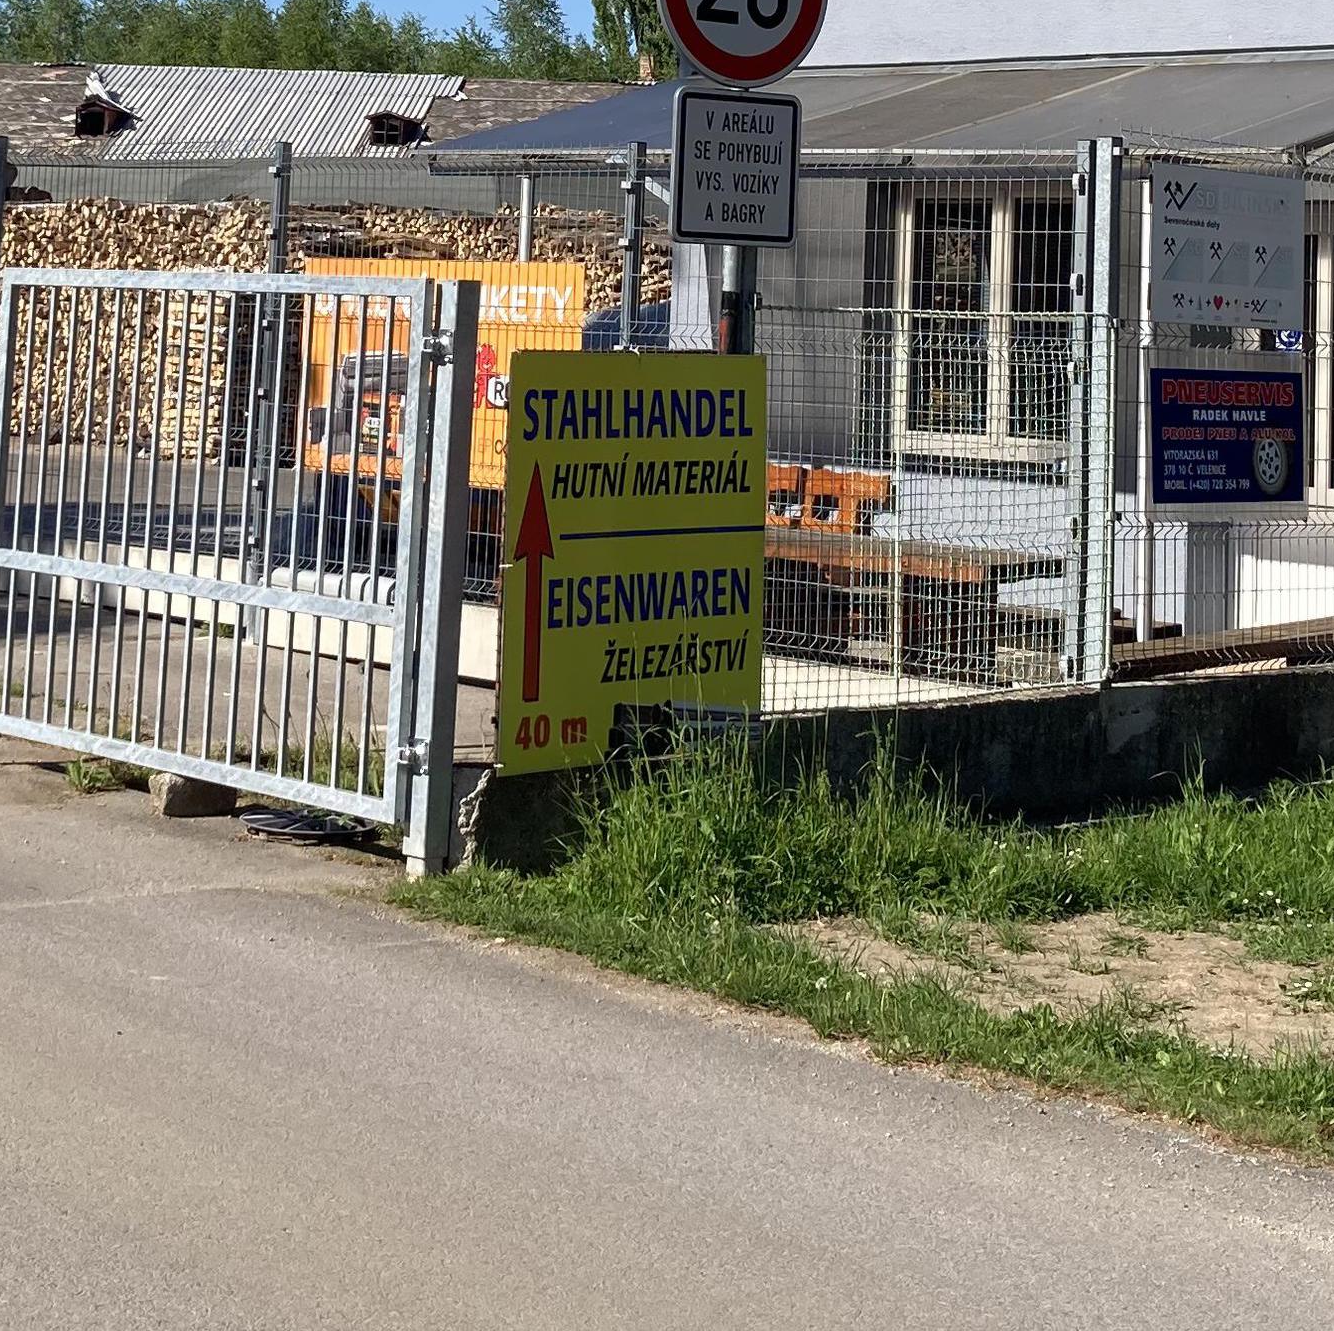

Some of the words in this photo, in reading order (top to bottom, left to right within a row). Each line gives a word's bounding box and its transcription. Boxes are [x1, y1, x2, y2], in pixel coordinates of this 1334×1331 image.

[706, 111, 715, 131] V
[722, 108, 774, 135] AREÁLU
[695, 141, 711, 160] SE
[718, 140, 782, 165] POHYBUJÍ
[696, 170, 725, 192] VYS.
[733, 168, 779, 195] VOZÍKY
[705, 202, 714, 222] A
[721, 204, 766, 224] BAGRY
[1196, 189, 1216, 210] SD
[479, 284, 573, 325] IKETY
[1162, 379, 1294, 407] PNEUSERVIS
[523, 389, 753, 442] STAHLHANDEL
[1192, 409, 1229, 421] RADEK
[1232, 410, 1266, 422] HAVLE
[1162, 427, 1204, 440] PRODEJ
[1207, 427, 1237, 440] PNEU
[1239, 428, 1248, 440] A
[1163, 449, 1205, 460] VITORAZSKÁ
[551, 453, 629, 499] HUTNÍ
[632, 451, 751, 498] MATERIÁL
[1164, 465, 1176, 476] 378
[1197, 465, 1226, 475] VELENICE
[547, 568, 750, 629] EISENWAREN
[601, 629, 748, 683] ŽELEZÁŘSTVÍ
[515, 715, 550, 750] 40
[561, 716, 588, 744] m
